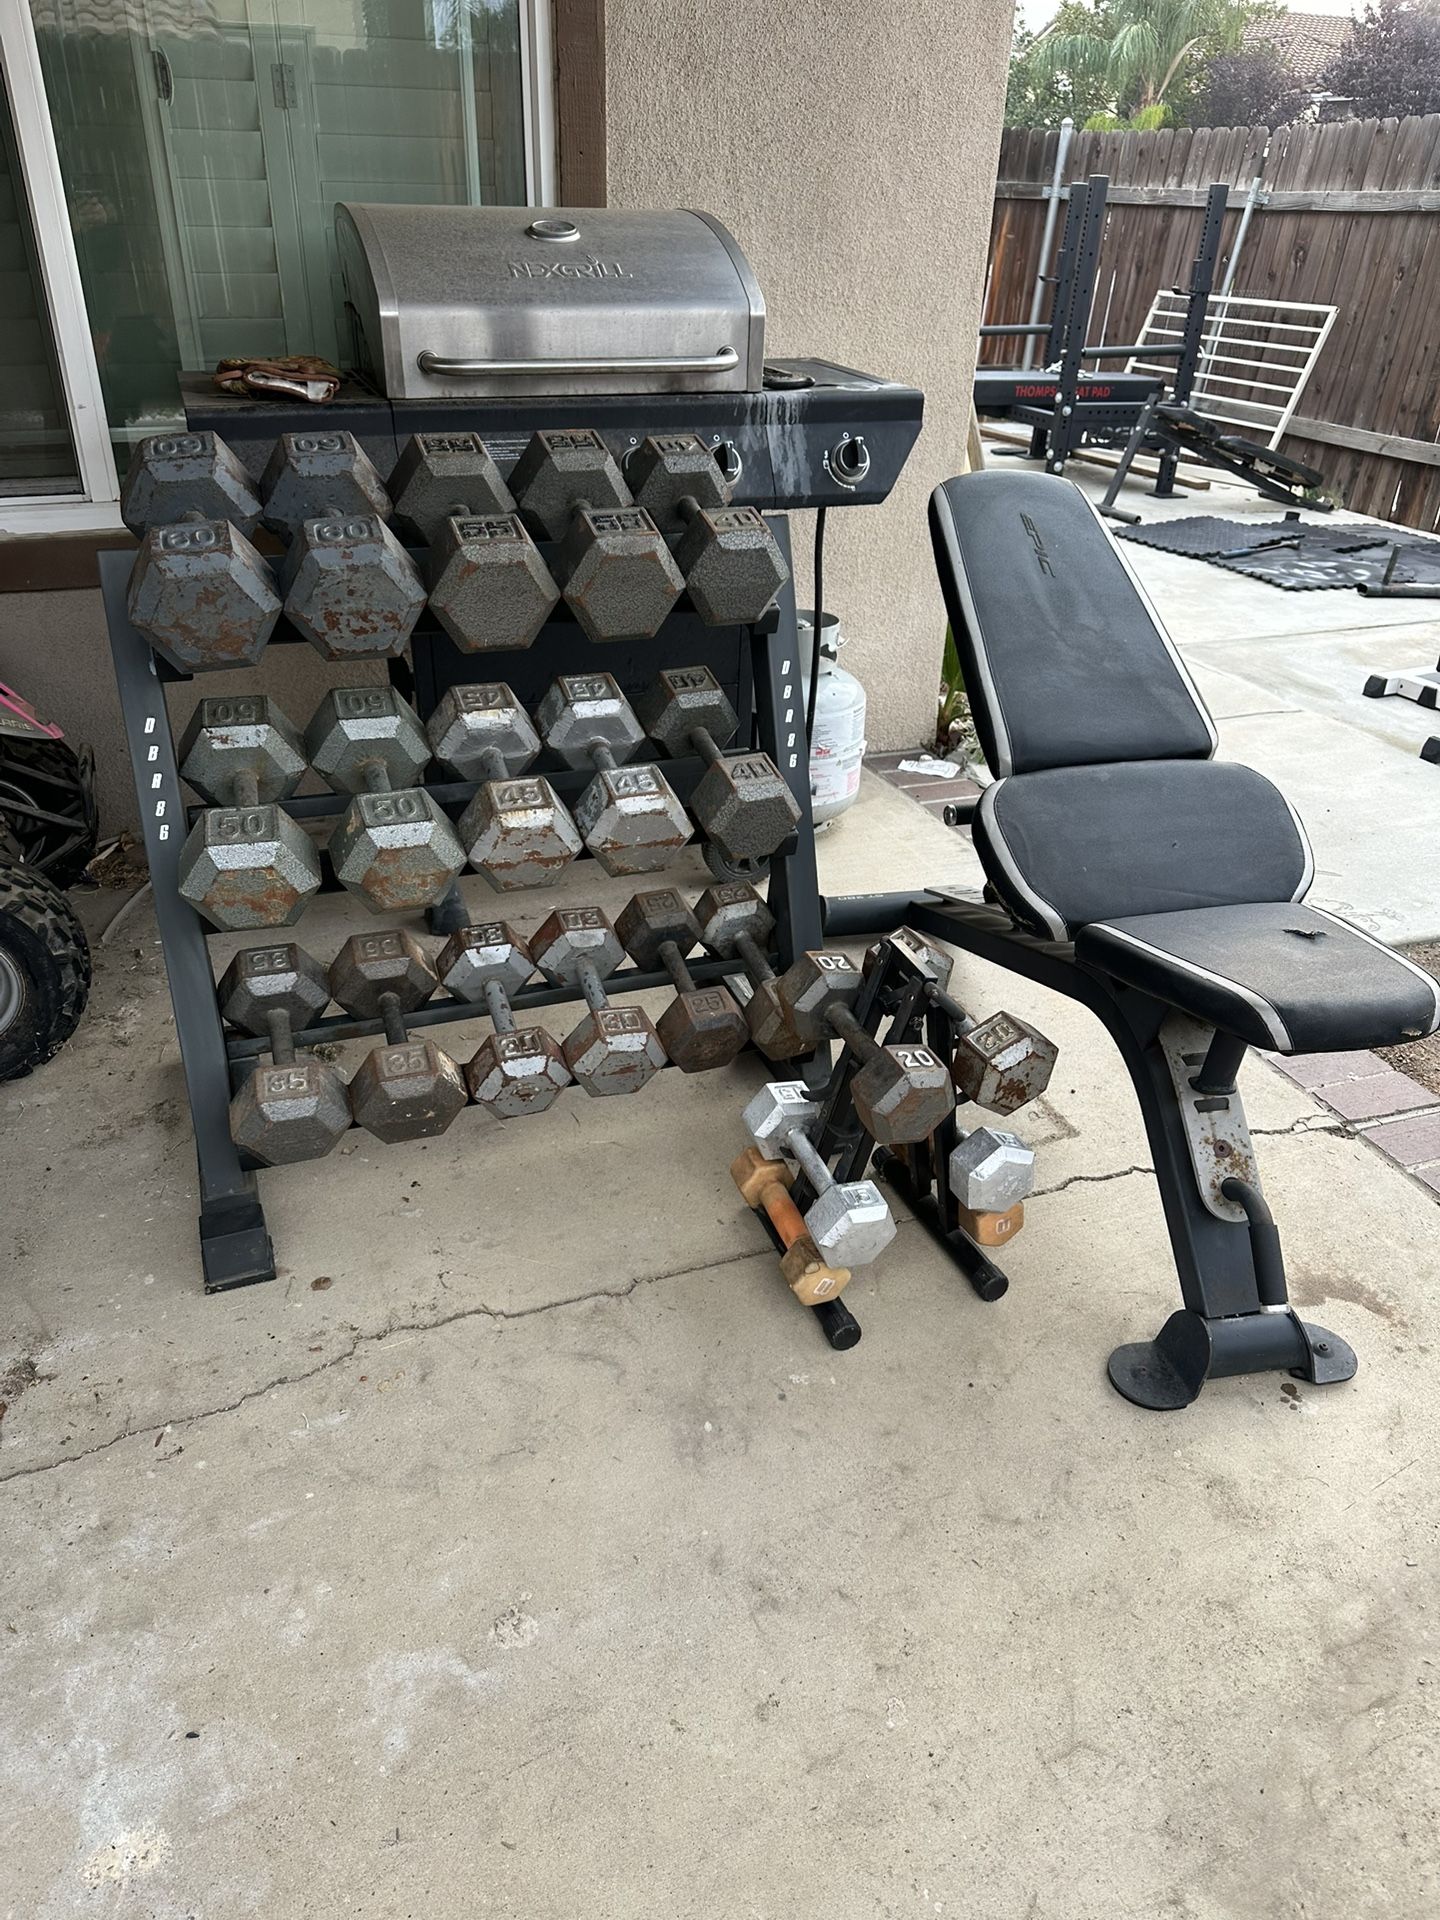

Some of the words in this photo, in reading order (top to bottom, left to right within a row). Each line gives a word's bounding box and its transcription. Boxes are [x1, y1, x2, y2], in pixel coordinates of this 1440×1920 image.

[1015, 385, 1056, 397] THOMPS
[1091, 387, 1110, 397] PAD
[462, 690, 500, 703] 45
[571, 682, 607, 698] 45
[214, 702, 256, 722] 50
[348, 693, 386, 713] 50
[730, 761, 772, 780] 40
[616, 773, 658, 794] 45
[500, 784, 543, 805] 45
[372, 799, 419, 819] 50
[217, 815, 267, 837] 50
[252, 951, 287, 971] 35
[817, 956, 853, 970] 20
[897, 1050, 935, 1067] 20
[267, 1073, 308, 1092] 35
